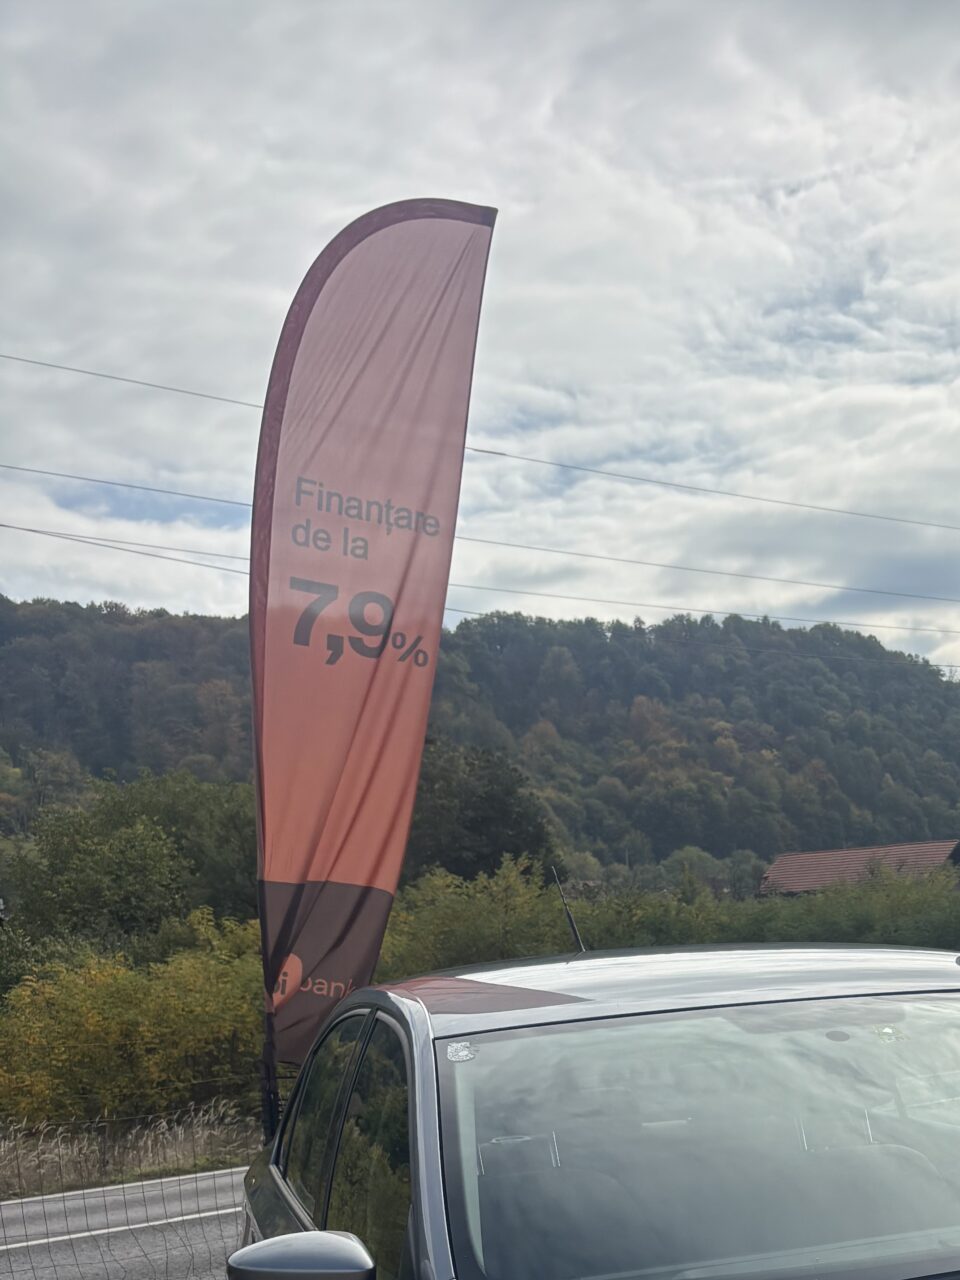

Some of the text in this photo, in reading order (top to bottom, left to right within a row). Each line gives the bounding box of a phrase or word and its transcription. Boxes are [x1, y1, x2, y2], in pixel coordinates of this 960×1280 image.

[291, 518, 369, 560] de la
[288, 576, 430, 668] 7,9%
